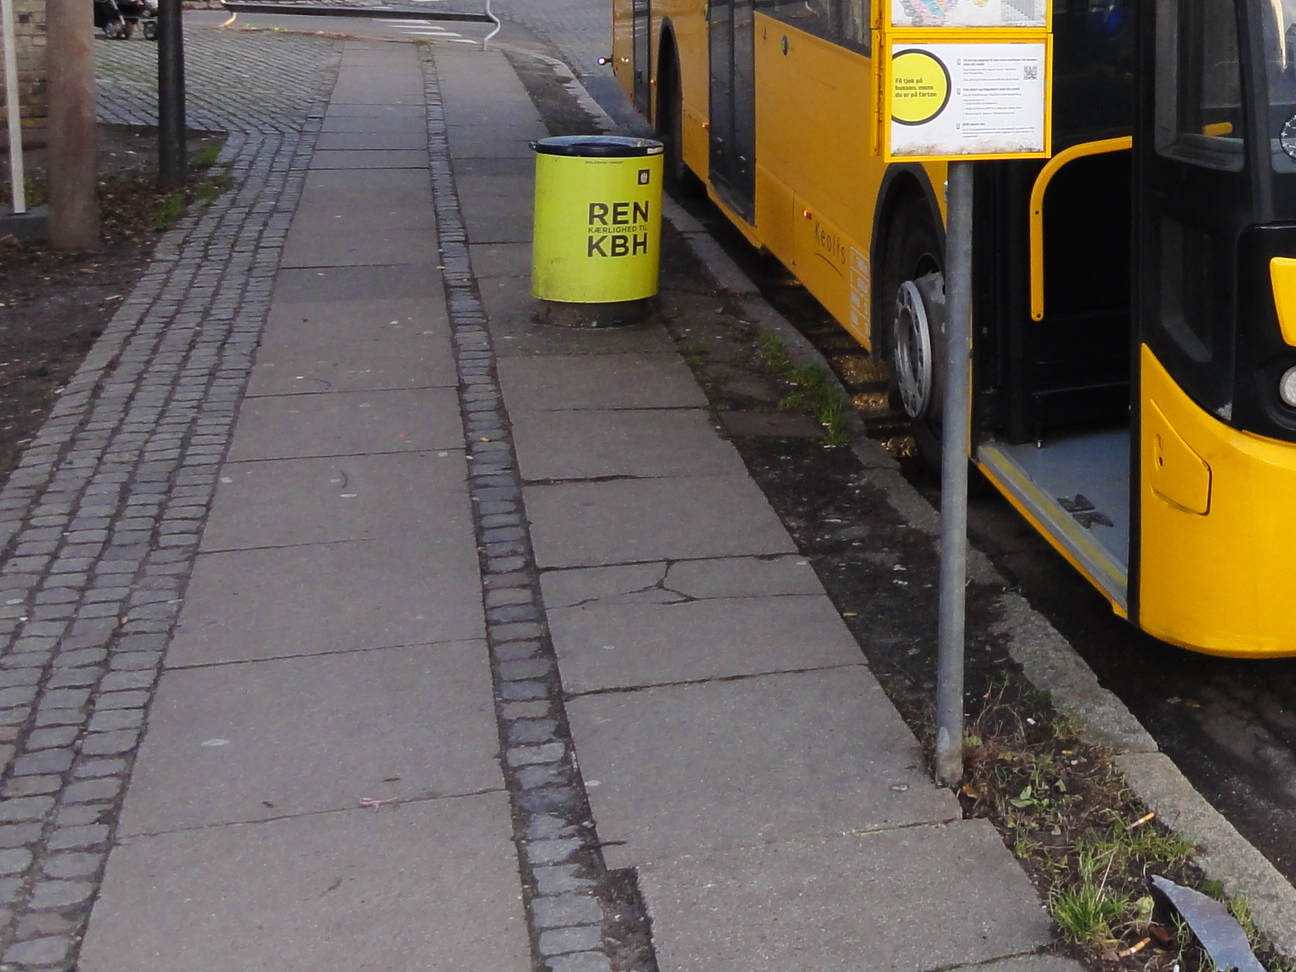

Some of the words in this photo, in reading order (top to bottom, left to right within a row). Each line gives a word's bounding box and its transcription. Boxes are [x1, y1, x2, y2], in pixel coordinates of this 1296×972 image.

[588, 200, 650, 226] REN
[588, 225, 638, 234] KÆRLIGHED
[587, 233, 648, 258] KBH
[815, 222, 846, 265] Keolis
